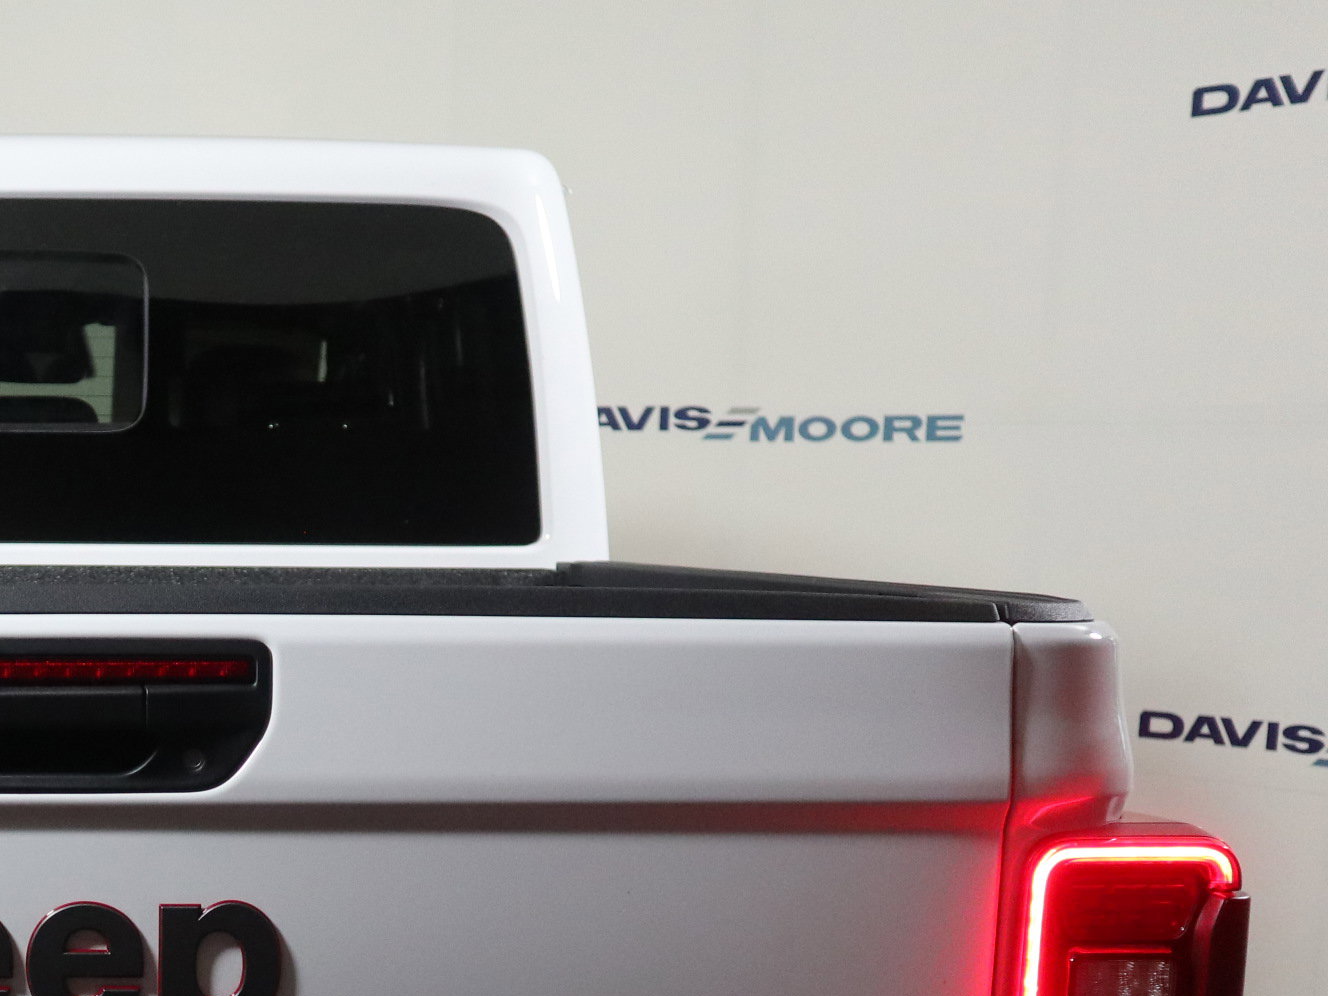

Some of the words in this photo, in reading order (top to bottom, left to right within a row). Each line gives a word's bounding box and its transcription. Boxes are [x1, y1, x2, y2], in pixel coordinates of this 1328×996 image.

[1191, 69, 1328, 117] DAV
[749, 415, 965, 443] MOORE
[1138, 710, 1326, 755] DAVIS
